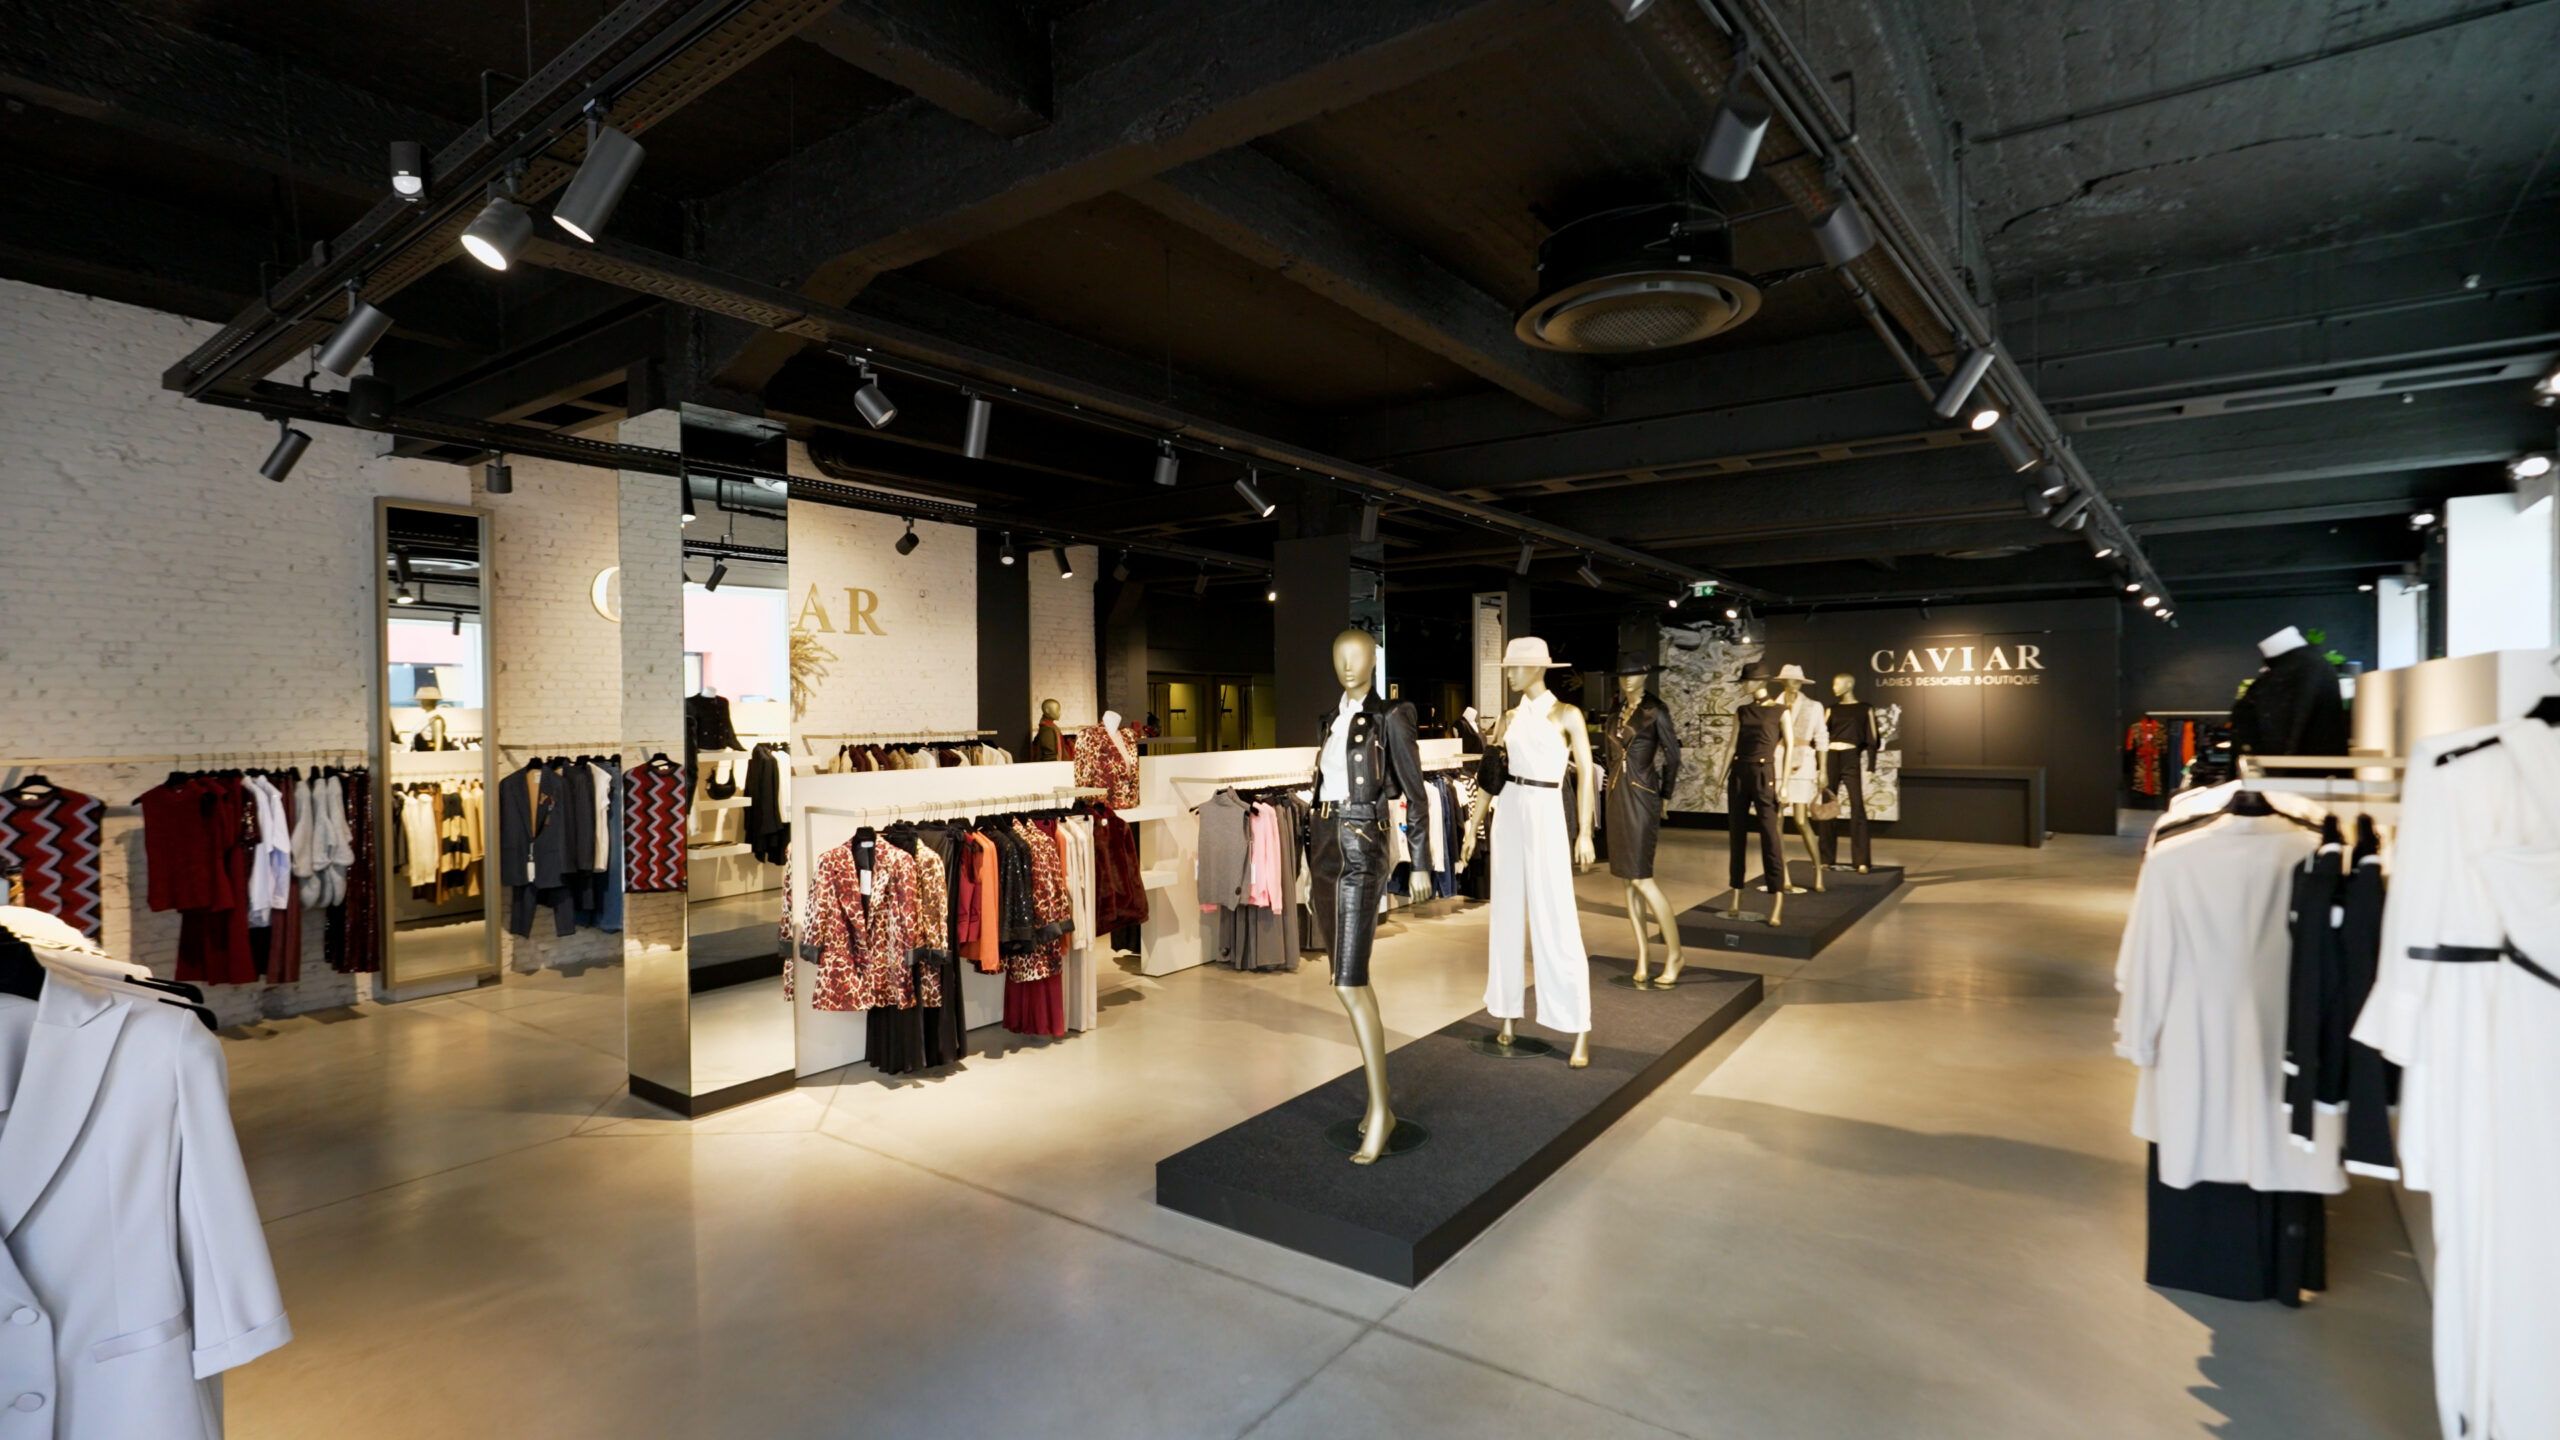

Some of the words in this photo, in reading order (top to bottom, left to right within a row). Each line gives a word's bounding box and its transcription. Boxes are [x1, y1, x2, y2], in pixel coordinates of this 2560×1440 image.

[1870, 644, 2046, 673] CAVIAR
[1875, 677, 1912, 687] LADIES
[1915, 675, 1971, 686] DESIGNER
[1974, 674, 2040, 685] BOUTIQUE
